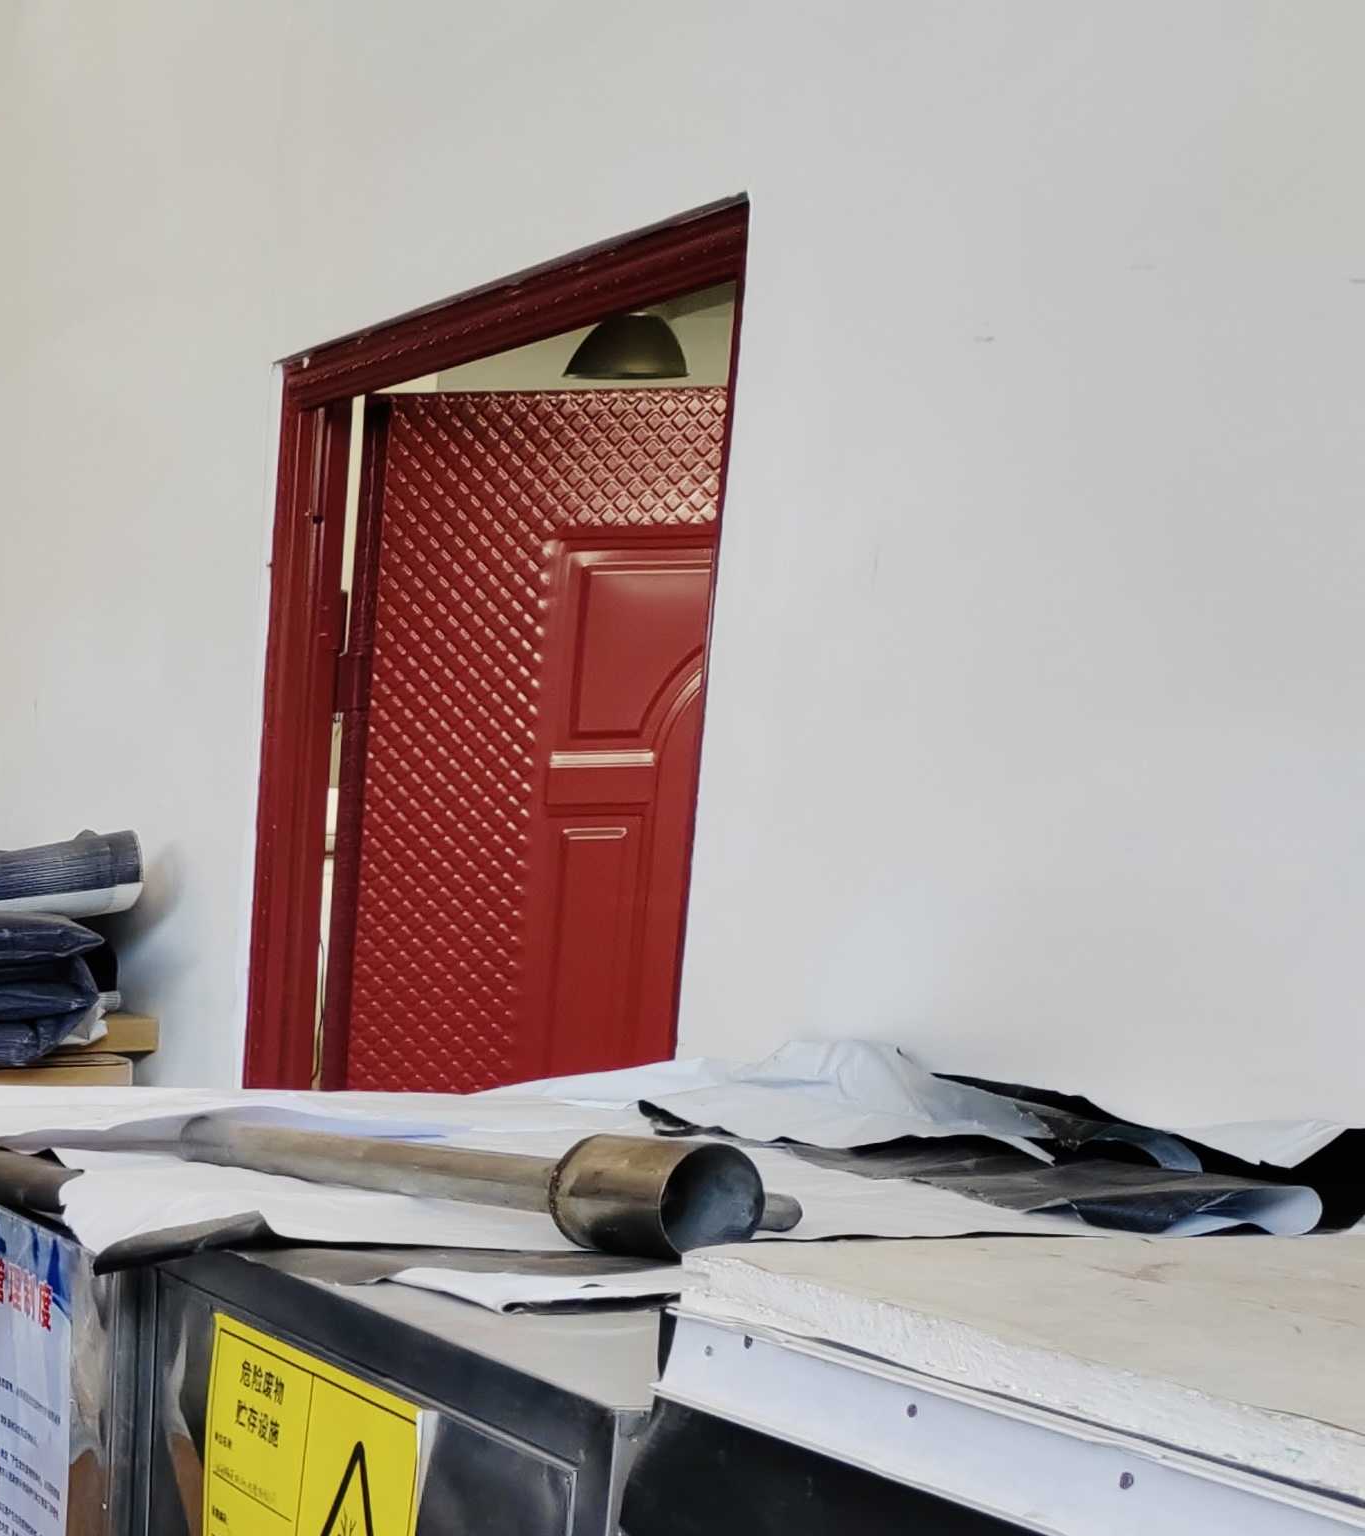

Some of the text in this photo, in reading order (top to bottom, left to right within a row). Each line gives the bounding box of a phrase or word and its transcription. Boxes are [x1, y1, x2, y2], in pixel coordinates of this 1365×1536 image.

[239, 1361, 285, 1406] 危险废物
[234, 1400, 280, 1449] 贮存设施
